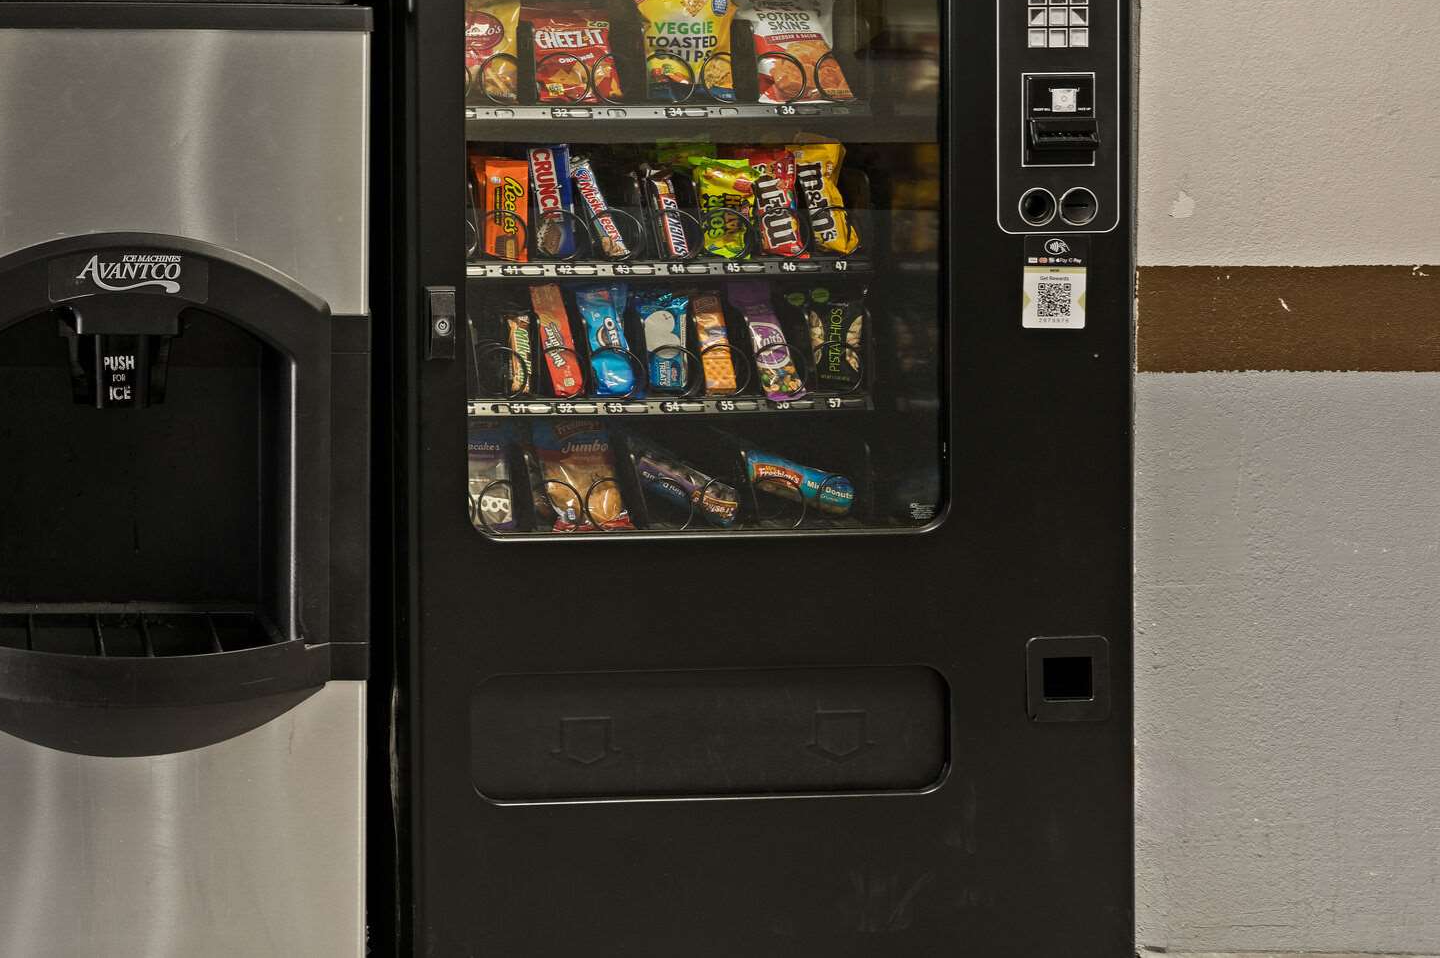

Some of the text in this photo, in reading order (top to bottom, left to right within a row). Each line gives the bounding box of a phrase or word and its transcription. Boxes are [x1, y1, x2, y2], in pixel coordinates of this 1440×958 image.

[757, 10, 810, 23] POTATO
[654, 21, 713, 35] VEGGIE
[770, 21, 811, 31] SKINS
[647, 35, 718, 49] TOASTED
[655, 50, 713, 62] CHIPS
[555, 108, 569, 118] 32
[668, 108, 682, 117] 34
[782, 106, 795, 115] 36
[532, 149, 561, 219] CRUNCH
[707, 196, 725, 238] SOUR
[76, 255, 181, 284] AVANTCO
[671, 264, 685, 273] 44
[727, 263, 740, 272] 45
[783, 262, 796, 271] 46
[835, 261, 847, 271] 47
[603, 317, 621, 348] ORE
[829, 308, 843, 373] PISTACHIOS
[103, 356, 135, 371] PUSH
[112, 373, 126, 382] FOR
[658, 361, 667, 386] TREATS
[109, 386, 132, 401] ICE
[610, 403, 623, 413] 53
[666, 402, 679, 412] 54
[721, 401, 734, 411] 55
[829, 398, 842, 408] 57
[513, 404, 526, 413] 51
[559, 404, 572, 413] 52
[469, 442, 500, 451] cakes
[562, 441, 609, 454] Jumbo
[825, 486, 854, 500] Donuts
